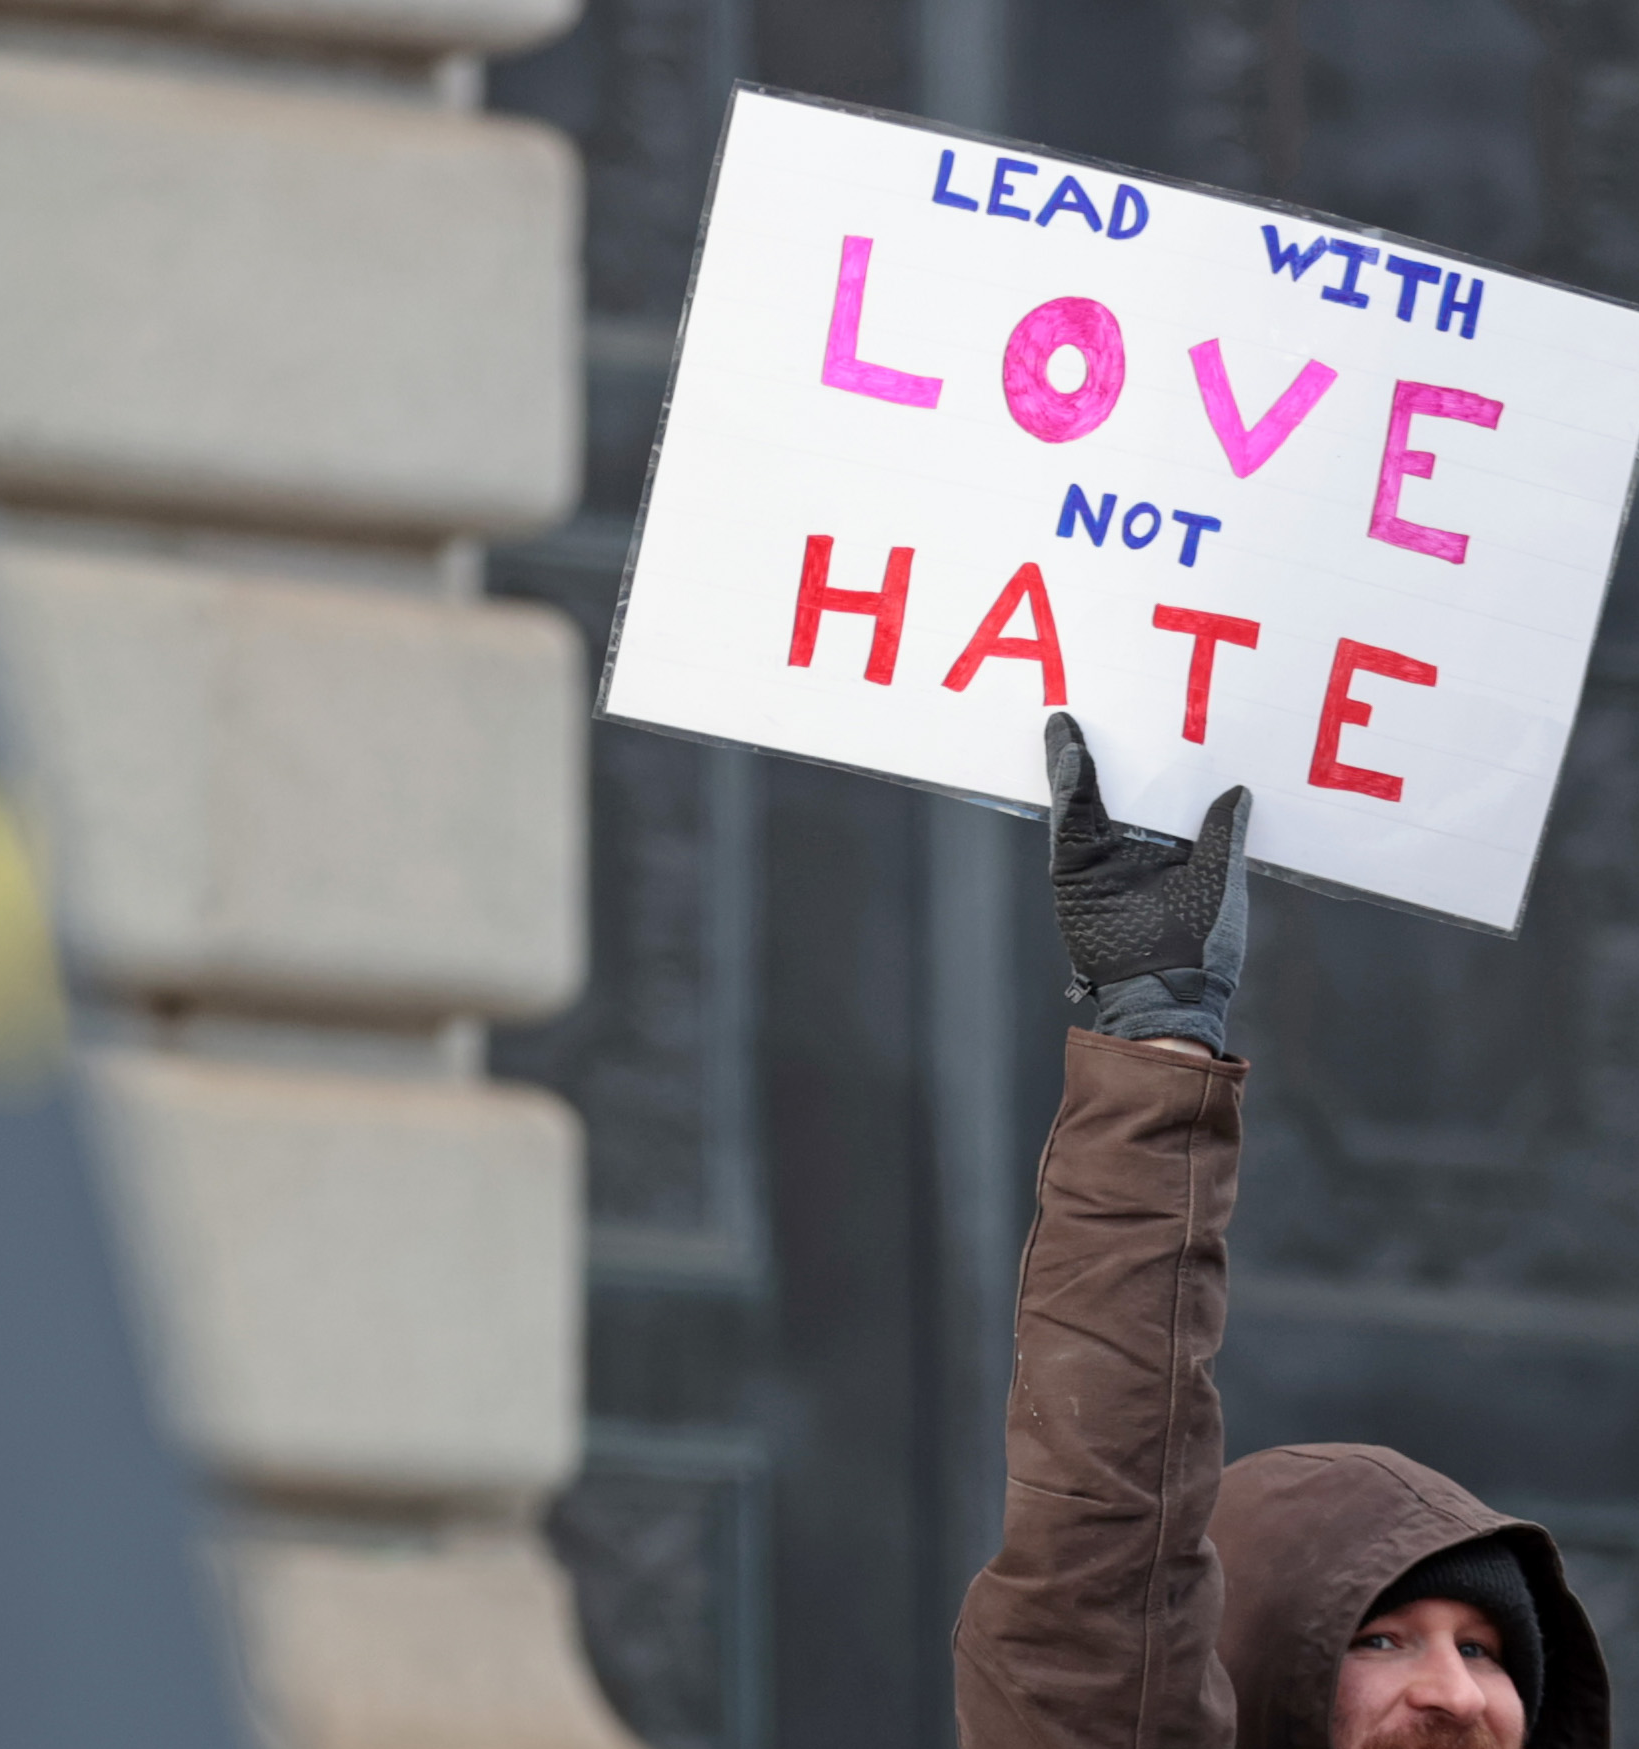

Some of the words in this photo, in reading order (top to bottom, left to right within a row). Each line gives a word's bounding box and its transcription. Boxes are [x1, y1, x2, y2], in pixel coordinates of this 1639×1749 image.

[933, 149, 1149, 240] LEAD
[1261, 225, 1484, 340] WITH
[821, 234, 1504, 565] LOVE
[1056, 484, 1222, 568] NOT
[788, 534, 1438, 803] HATE
